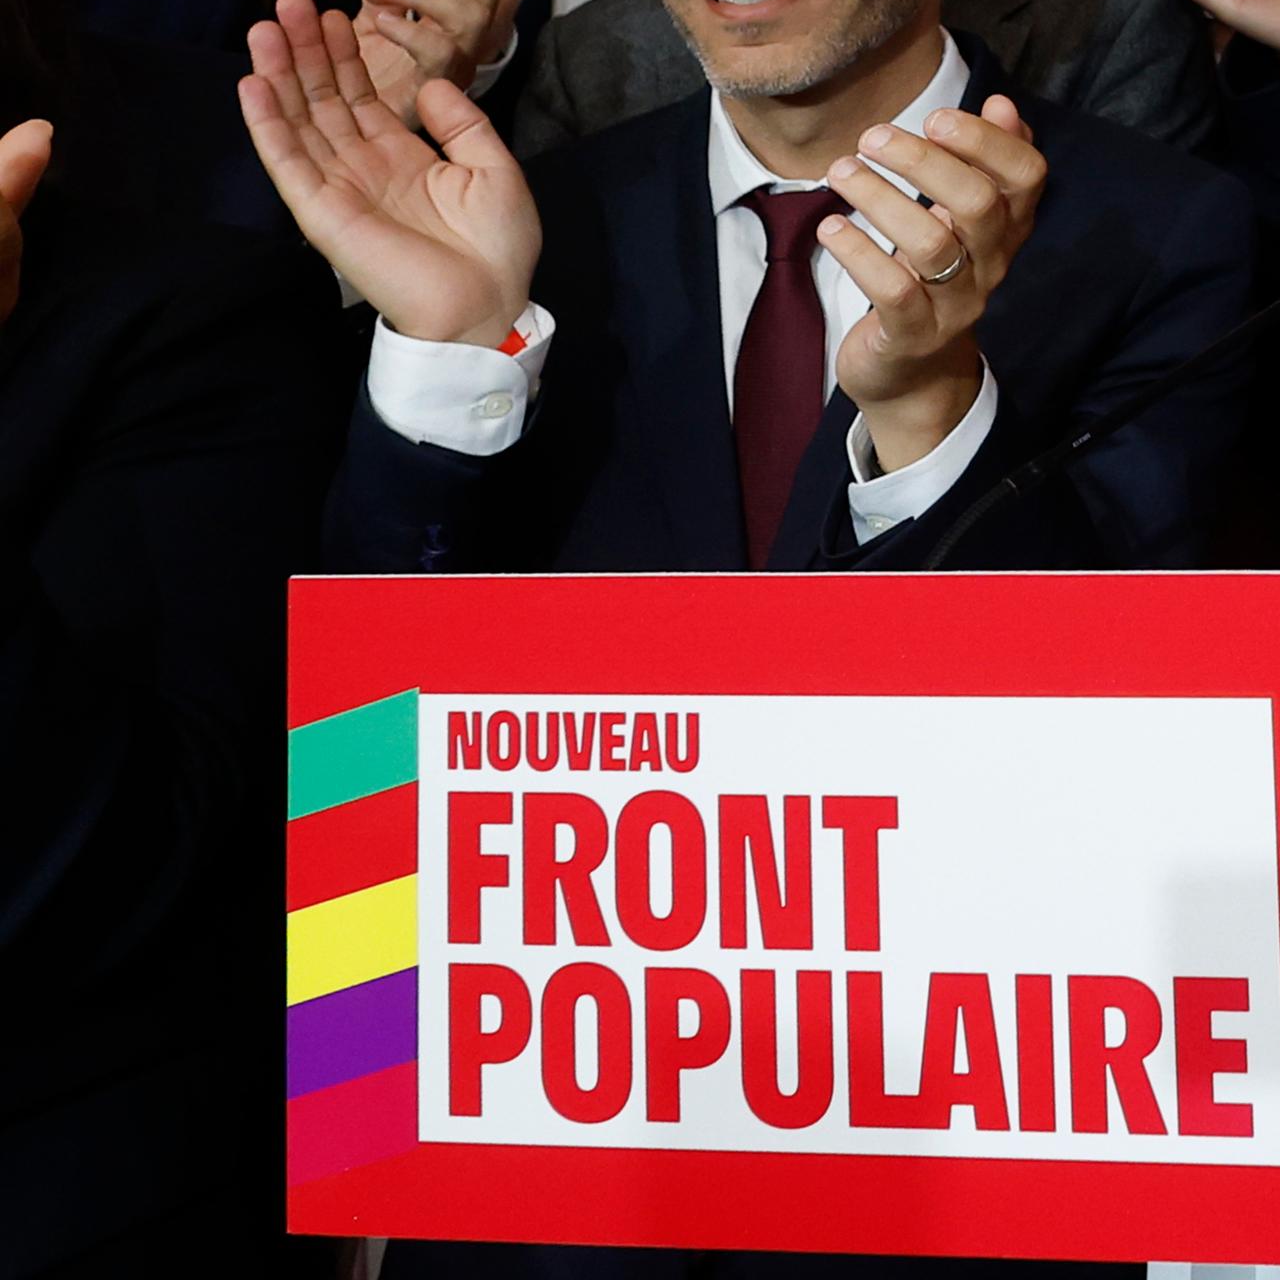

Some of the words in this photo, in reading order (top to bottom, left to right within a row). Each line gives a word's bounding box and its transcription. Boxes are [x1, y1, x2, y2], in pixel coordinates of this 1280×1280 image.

[448, 710, 700, 774] NOUVEAU
[447, 789, 899, 952] FRONT
[448, 961, 1254, 1138] POPULAIRE
